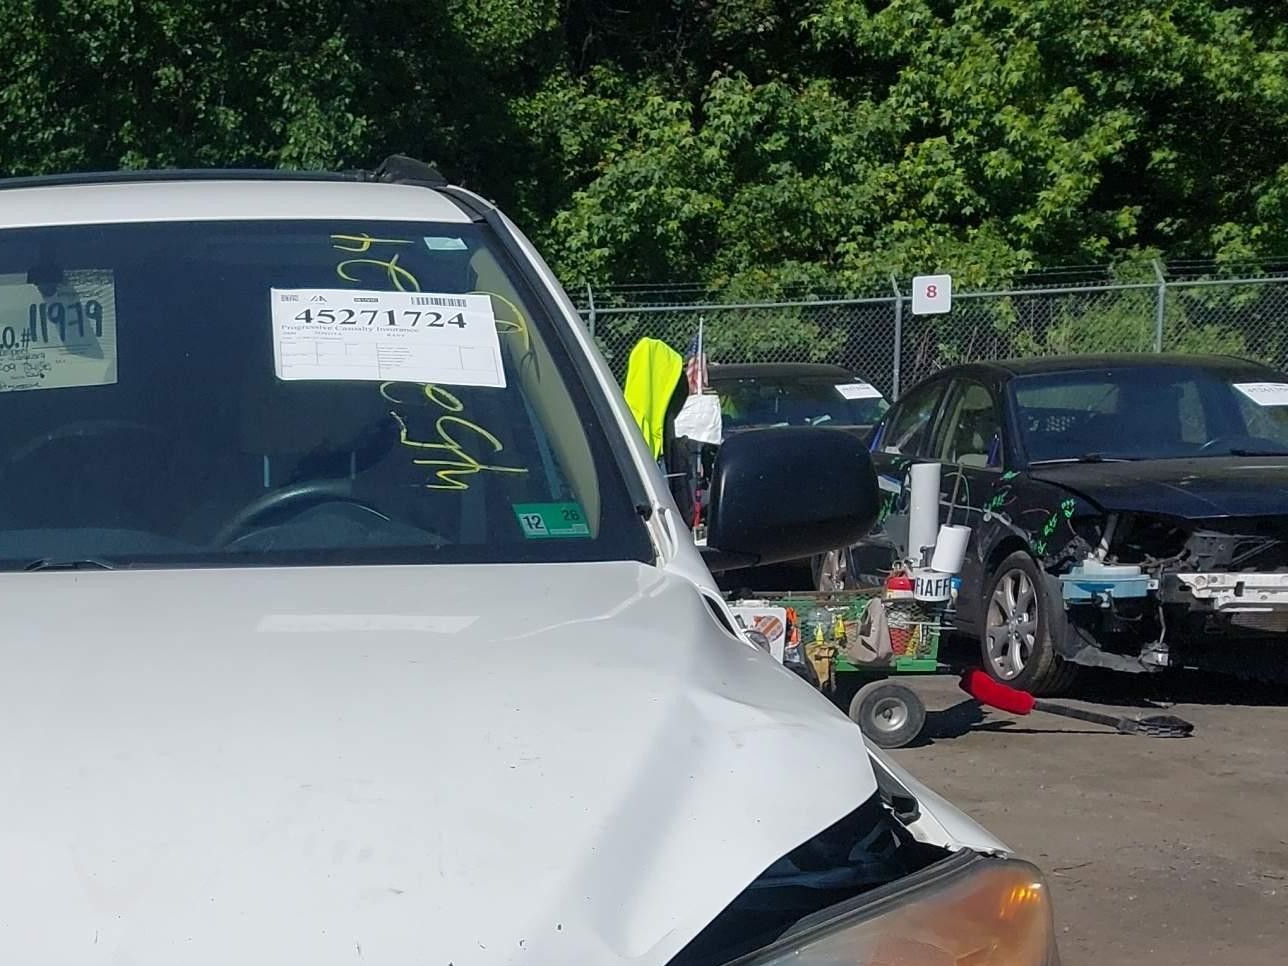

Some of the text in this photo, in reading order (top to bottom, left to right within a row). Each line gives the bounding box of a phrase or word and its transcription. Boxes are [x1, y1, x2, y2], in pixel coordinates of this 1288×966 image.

[926, 285, 937, 298] 8
[29, 299, 103, 343] 11979
[294, 308, 467, 329] 45271724
[522, 515, 545, 530] 12
